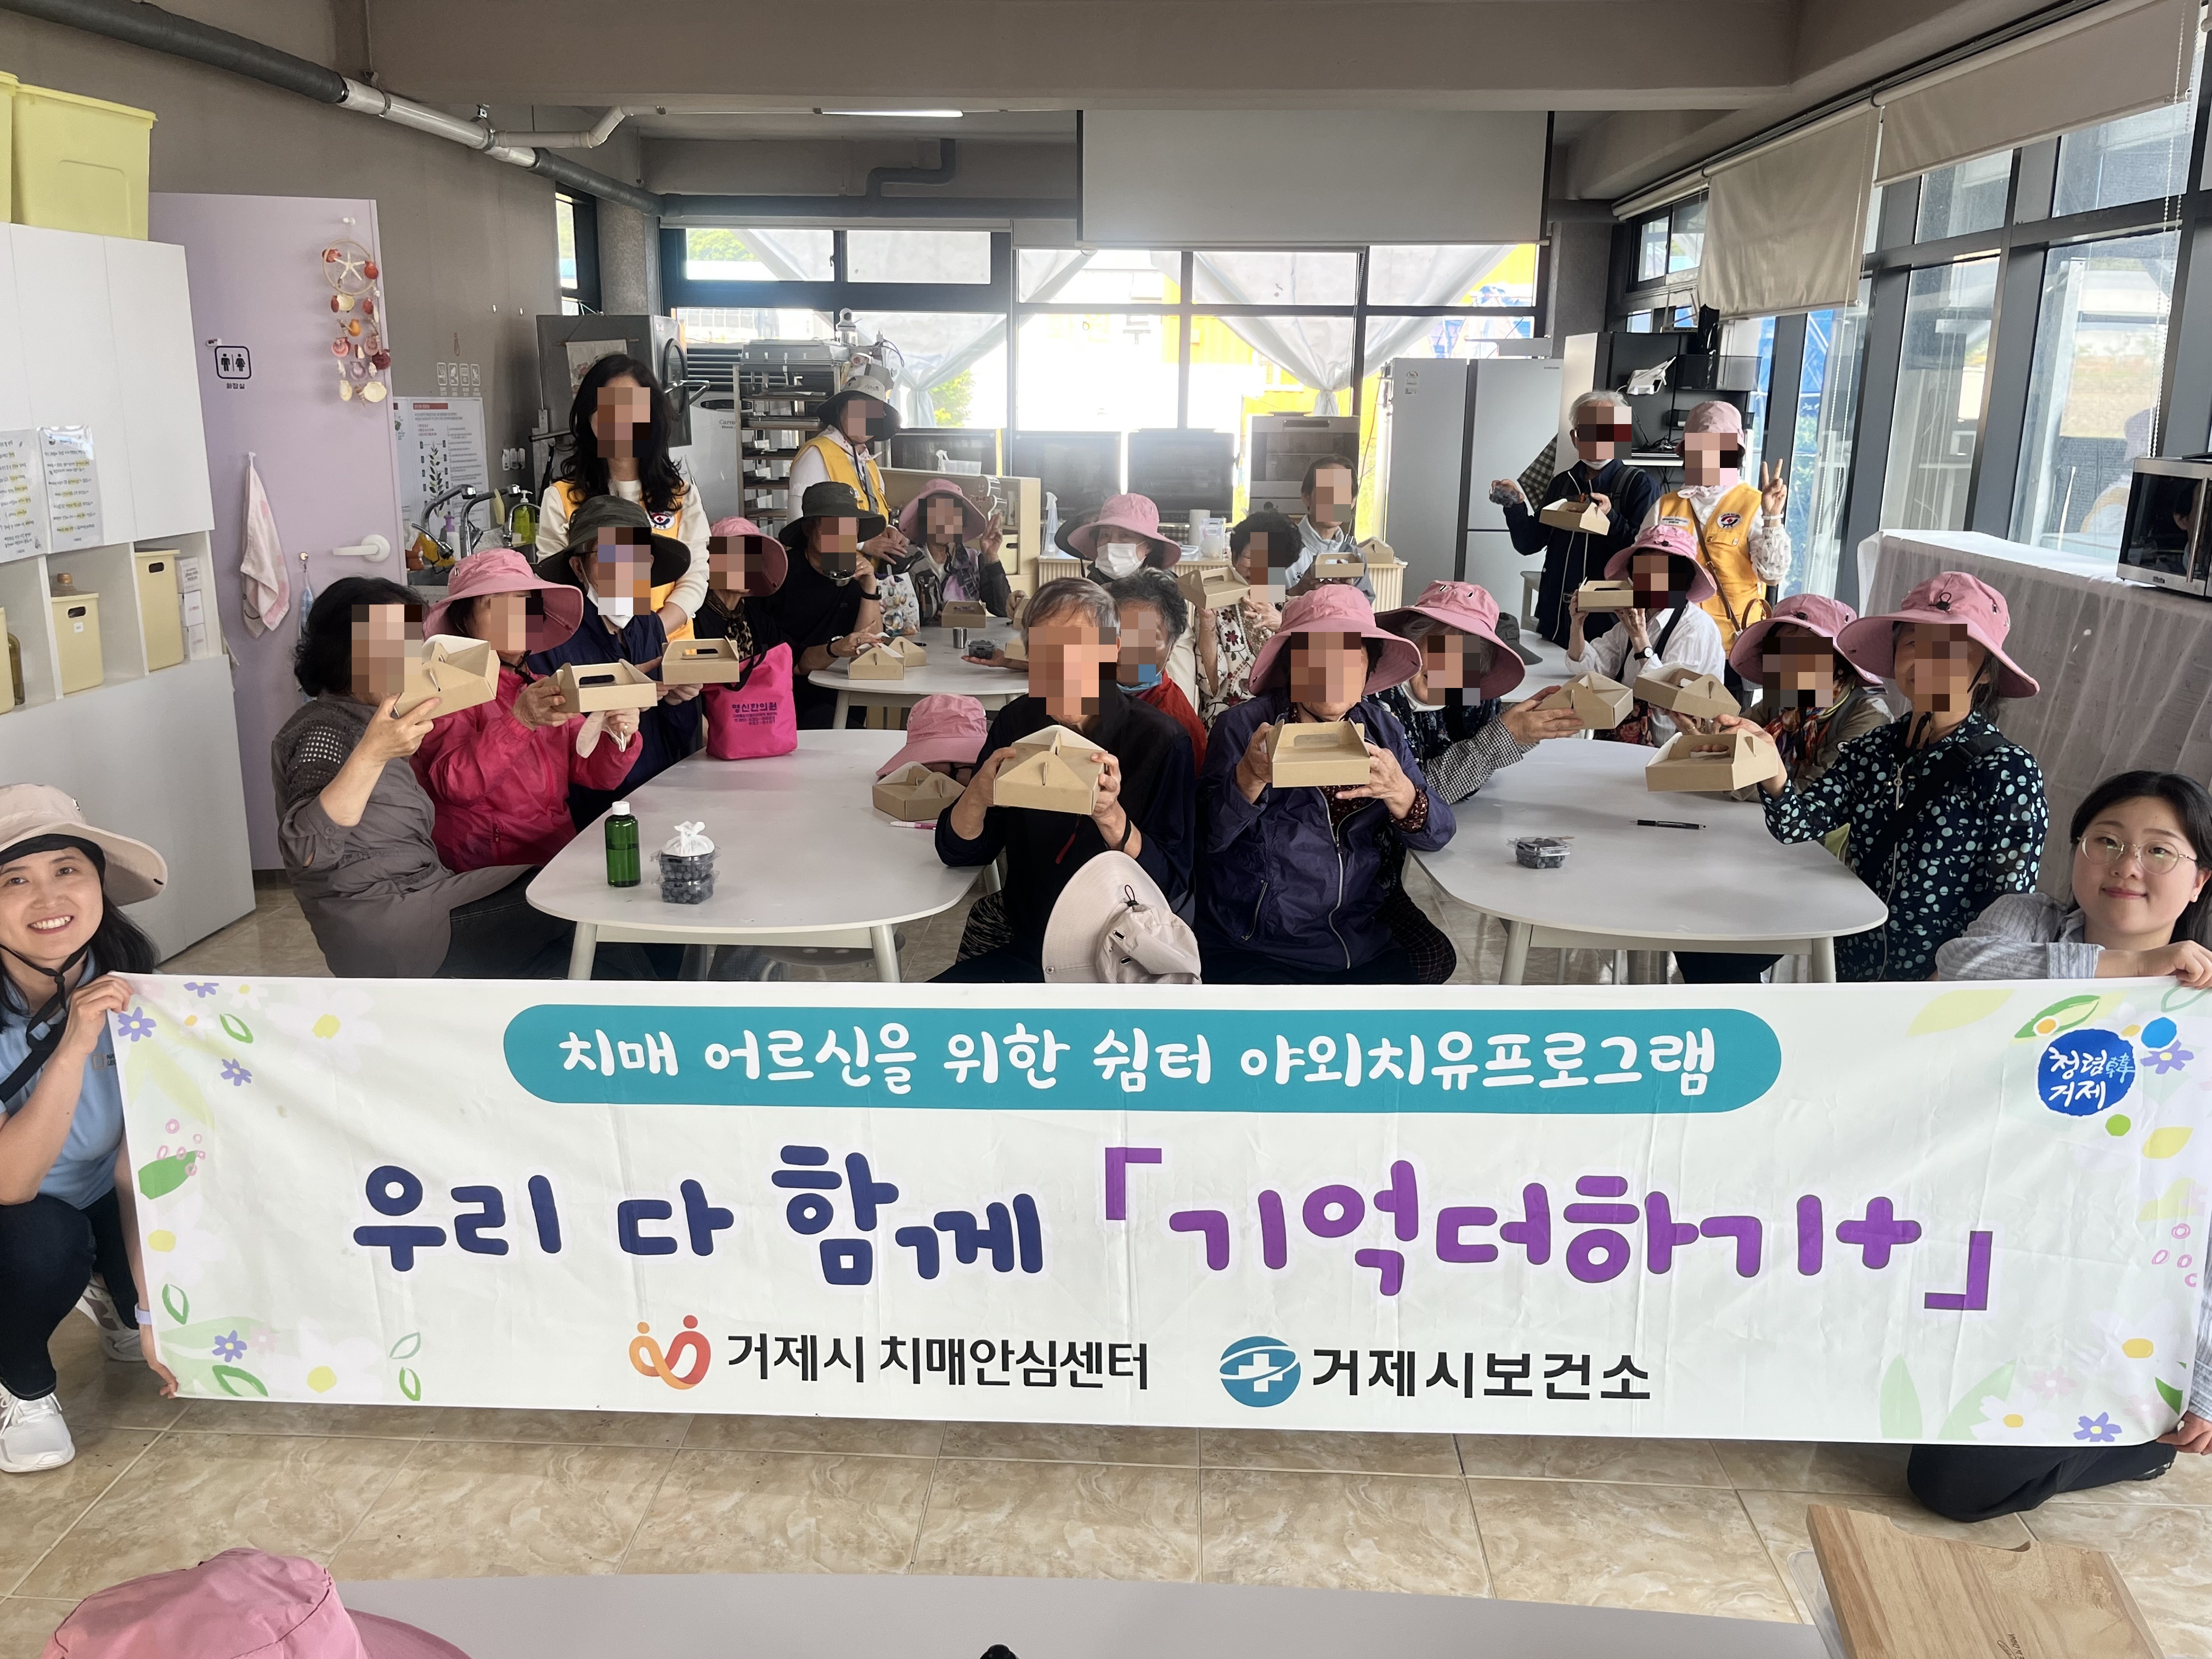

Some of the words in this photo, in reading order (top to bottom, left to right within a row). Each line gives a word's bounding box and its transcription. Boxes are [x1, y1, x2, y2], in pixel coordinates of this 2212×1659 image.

[558, 1029, 679, 1076] 치매
[704, 1022, 917, 1095] 어르신을
[943, 1023, 1071, 1089] 위한
[1092, 1027, 1211, 1092] 쉼터
[1240, 1027, 1715, 1096] 야외치유프로그램
[2049, 1080, 2107, 1110] 거제
[353, 1164, 562, 1272] 우리
[617, 1179, 734, 1256] 다
[771, 1145, 1043, 1286] 함께
[728, 1333, 865, 1383] 거제시
[879, 1335, 1148, 1390] 치매안심센터
[1312, 1349, 1651, 1401] 거제시보건소
